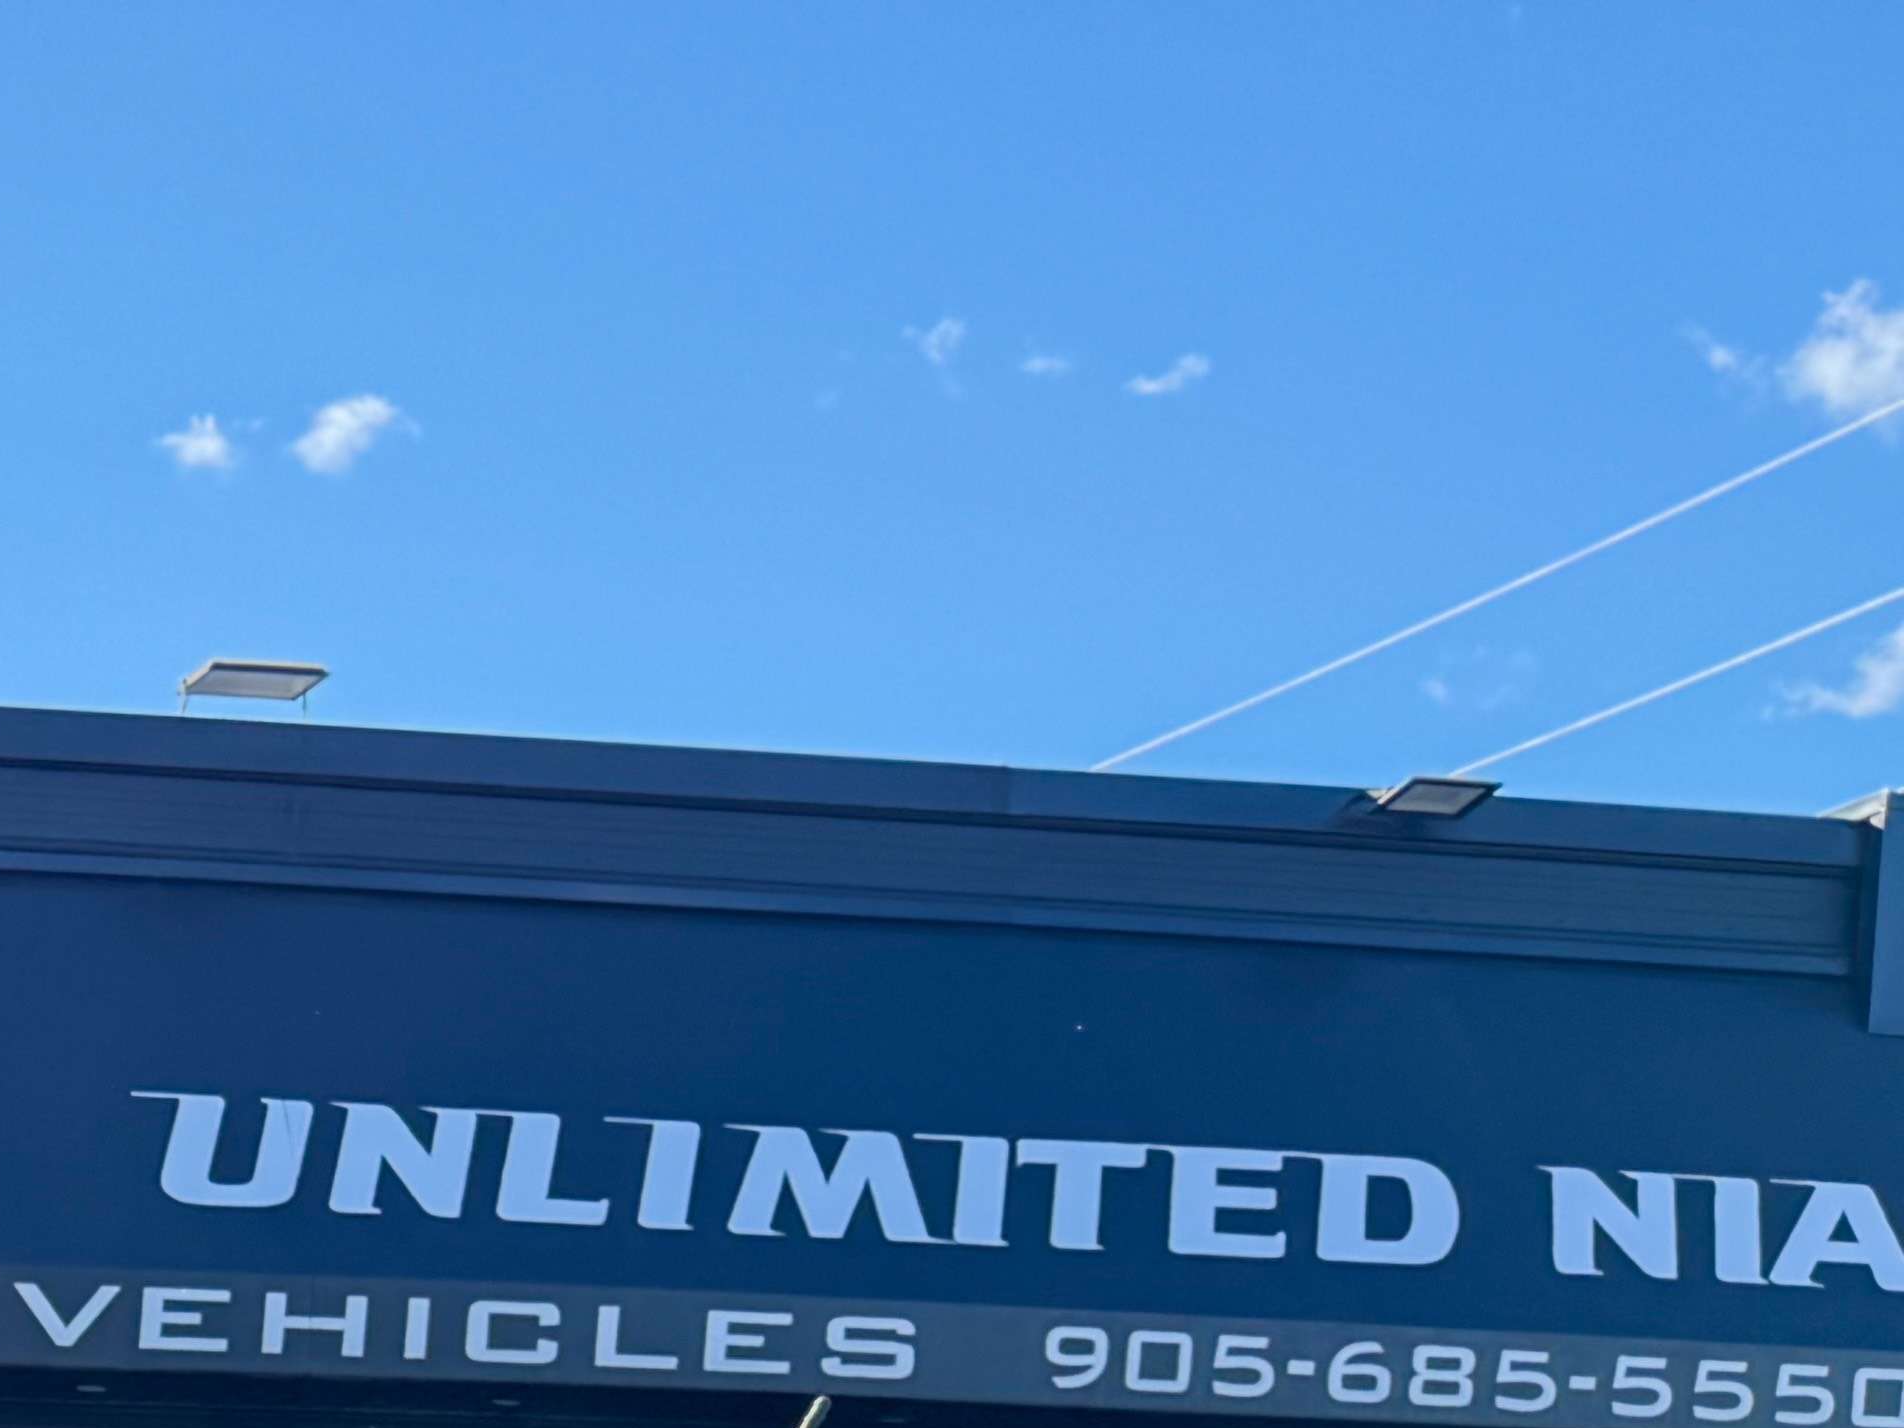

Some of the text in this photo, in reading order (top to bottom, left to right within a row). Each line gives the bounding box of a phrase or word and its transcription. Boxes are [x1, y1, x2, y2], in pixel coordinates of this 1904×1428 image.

[130, 1091, 1461, 1266] UNLIMITED
[1539, 1165, 1904, 1292] NIA
[13, 1282, 917, 1381] VEHICLES
